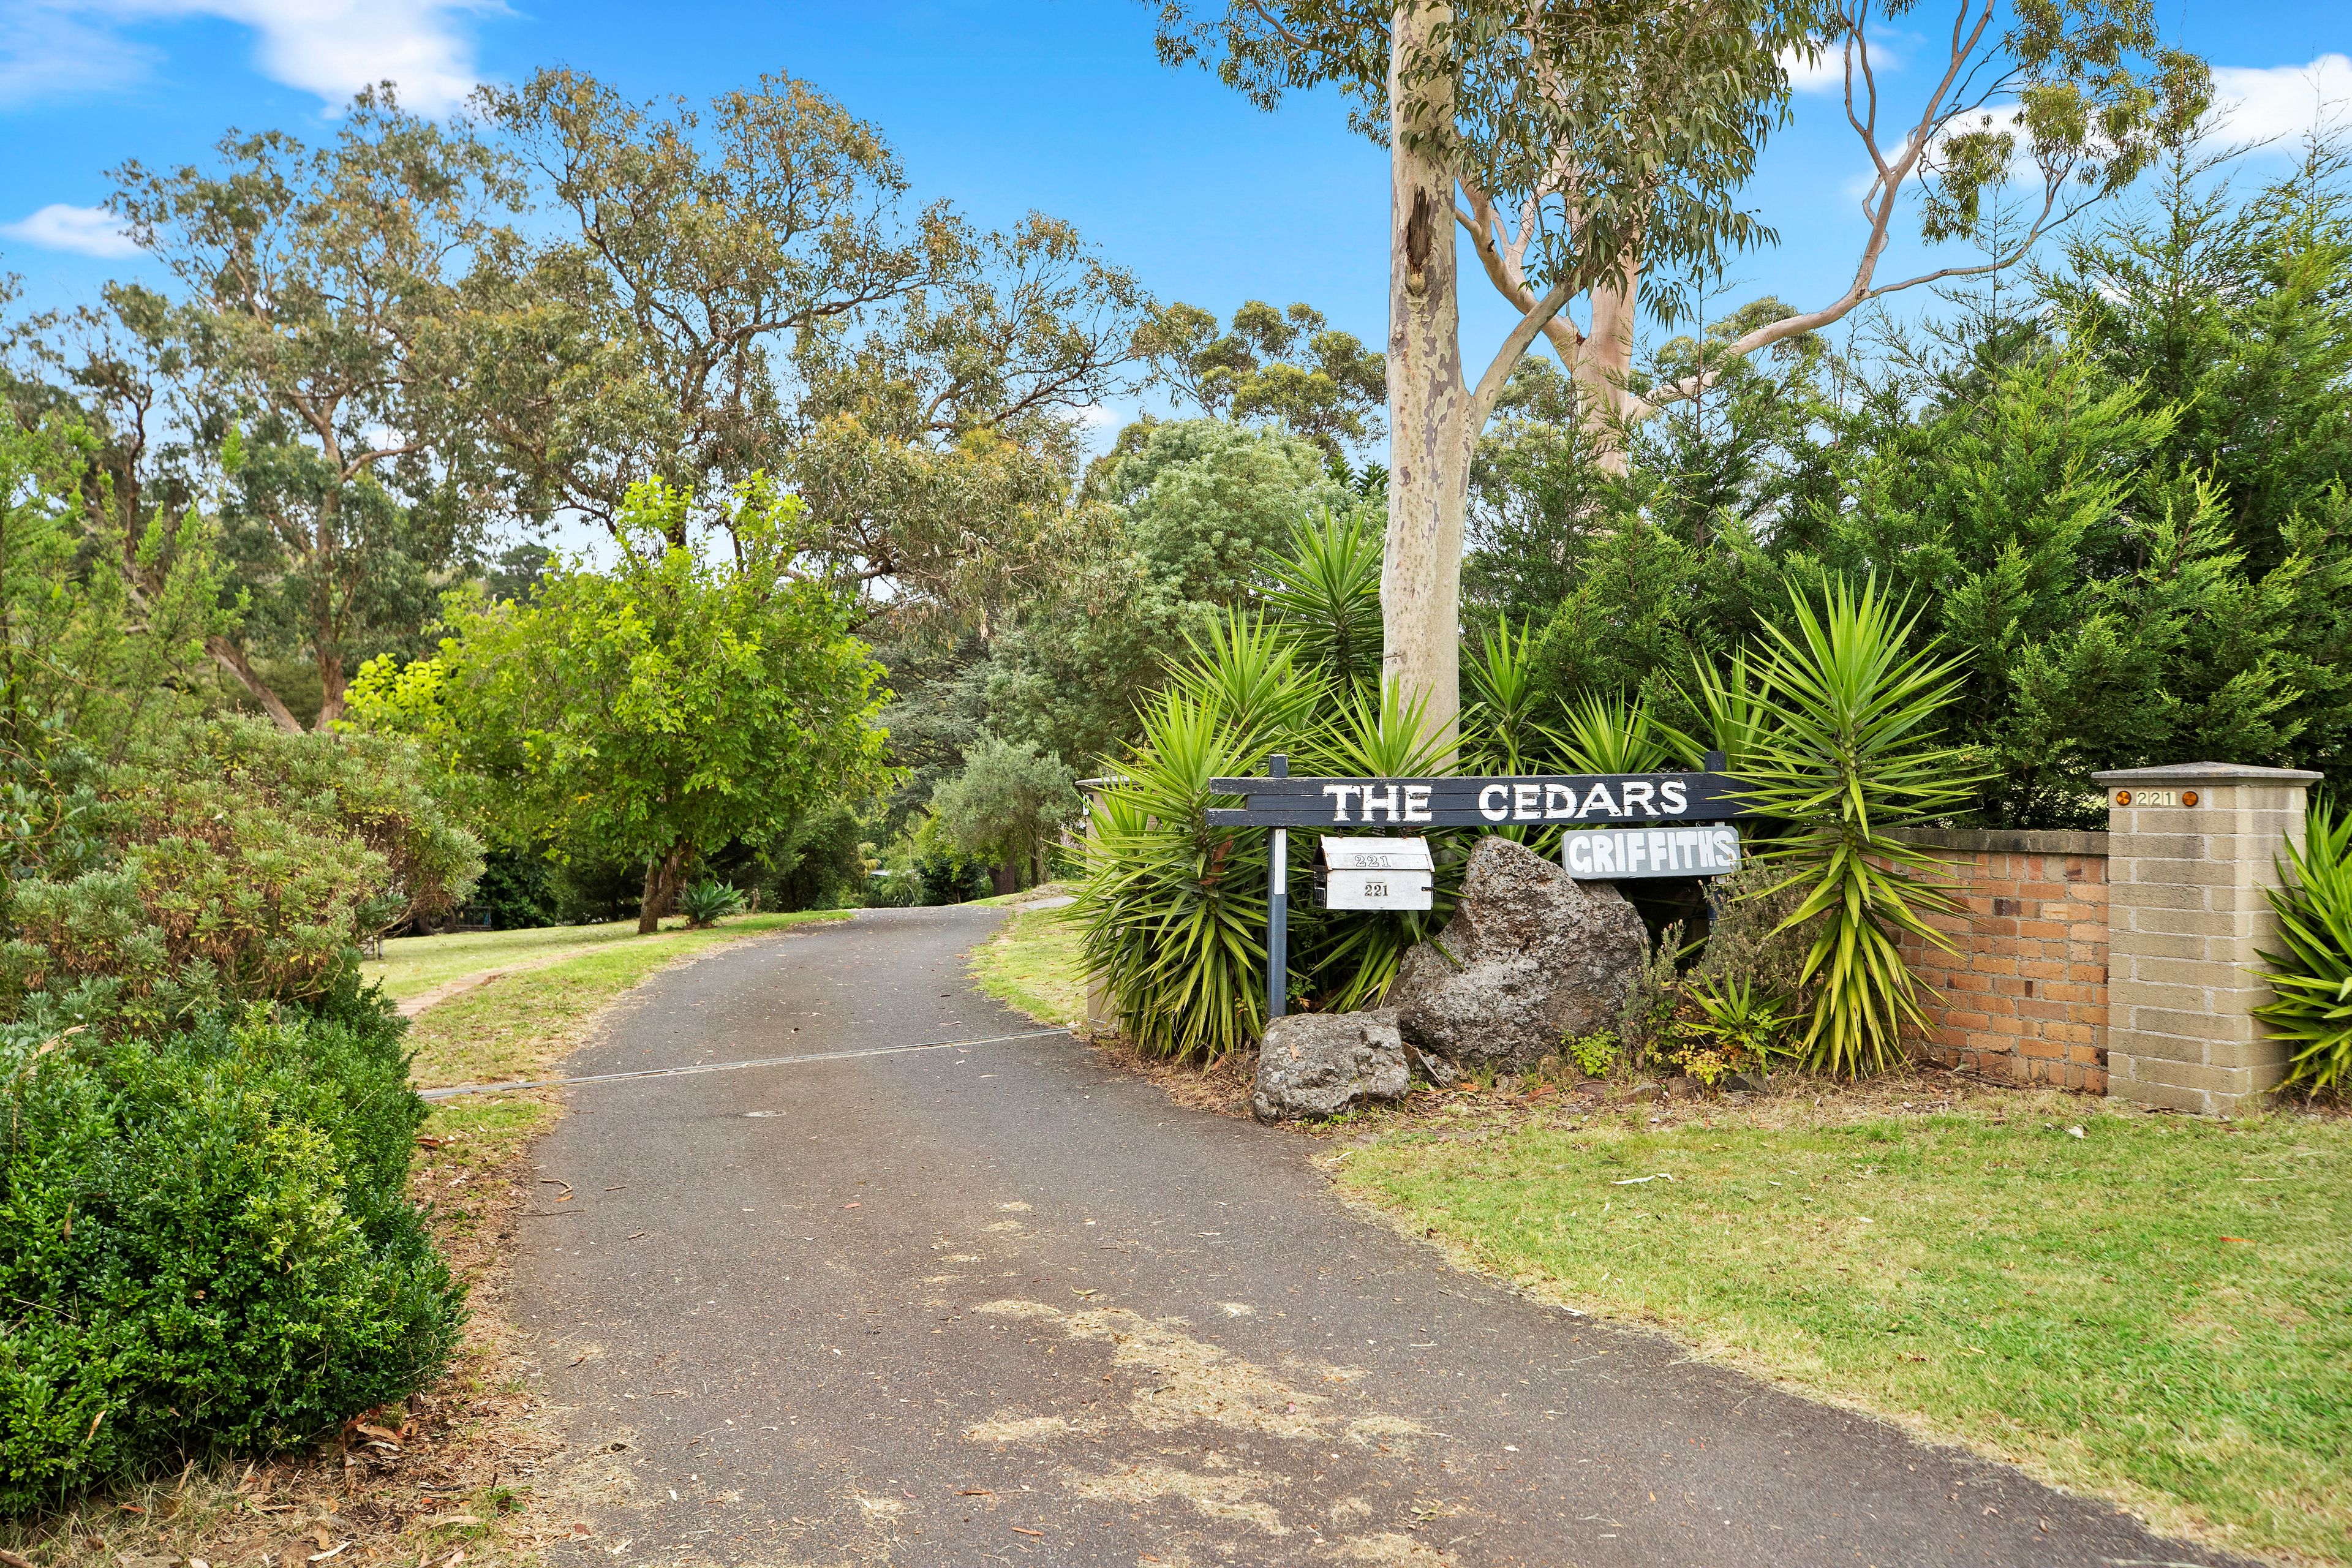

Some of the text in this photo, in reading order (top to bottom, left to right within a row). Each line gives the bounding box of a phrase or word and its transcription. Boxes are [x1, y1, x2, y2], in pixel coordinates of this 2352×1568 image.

[1322, 781, 1687, 822] THE CEDARS
[2137, 792, 2173, 805] 221
[1569, 831, 1736, 873] GRIFFITHS
[1354, 854, 1391, 868] 221
[1364, 884, 1388, 897] 221
